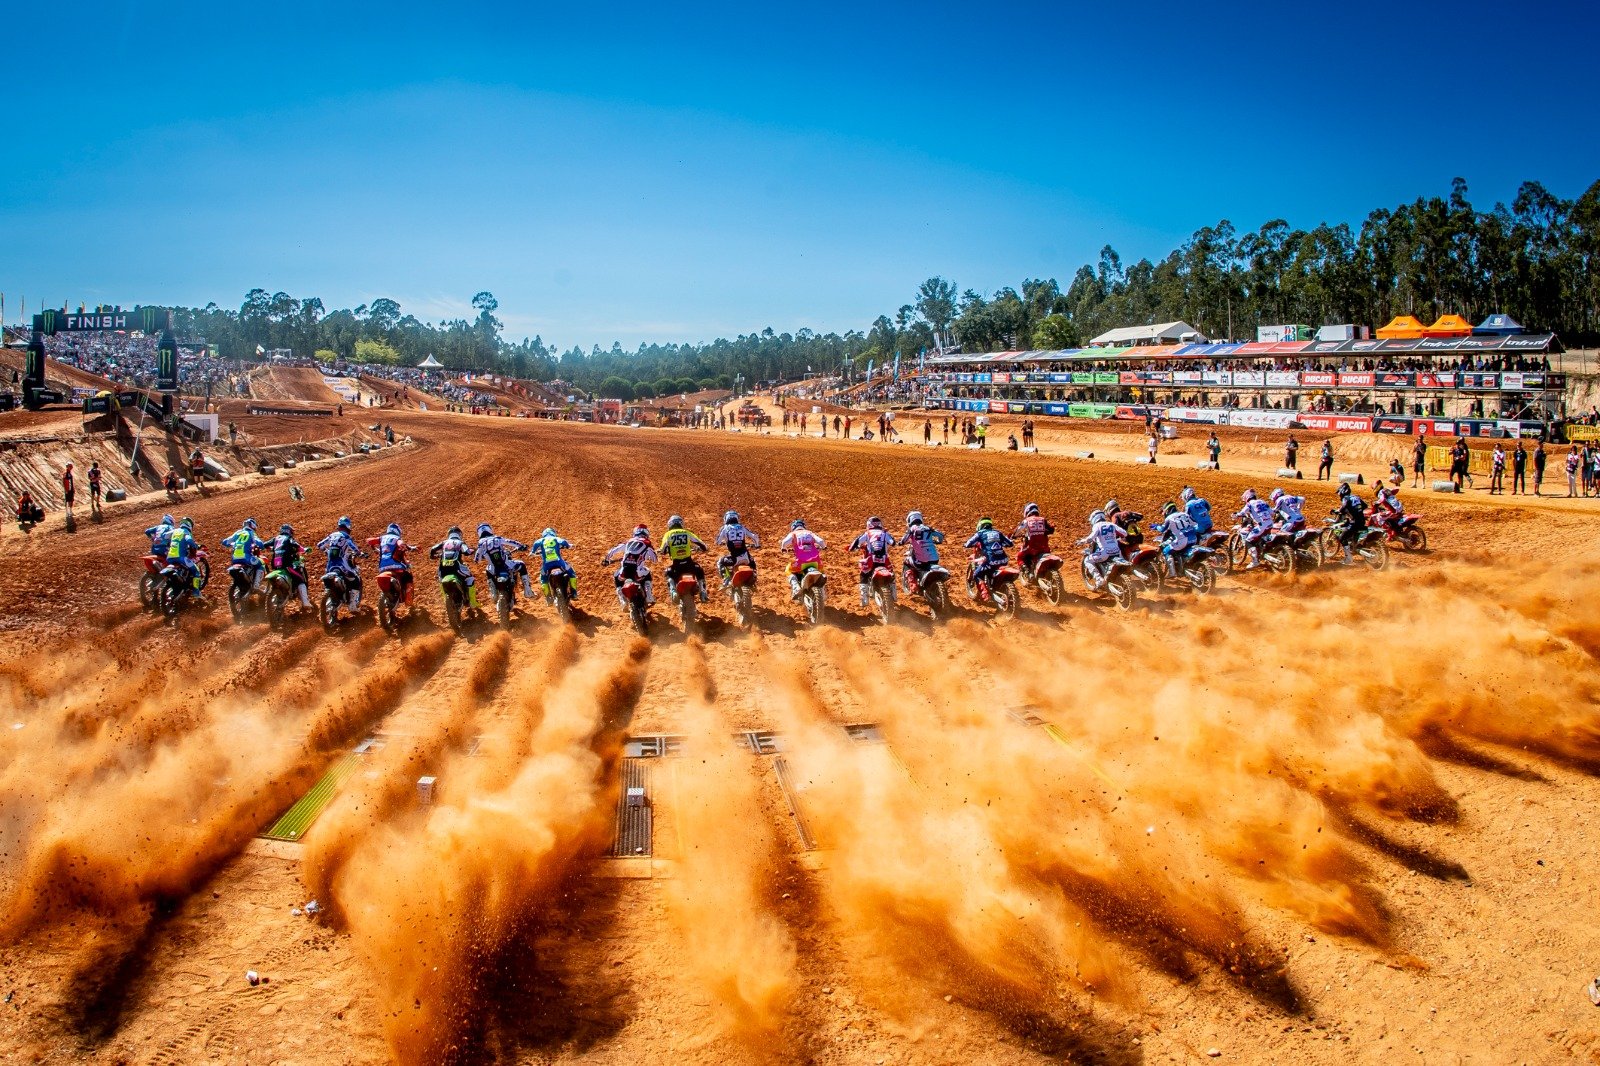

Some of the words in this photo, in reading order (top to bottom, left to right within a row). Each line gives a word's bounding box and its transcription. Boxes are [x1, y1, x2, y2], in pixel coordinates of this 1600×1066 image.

[67, 315, 126, 329] FINISH
[1304, 375, 1333, 383] DUCATI
[1341, 375, 1371, 384] DUCATI
[1336, 420, 1368, 430] DUCATI
[1101, 524, 1115, 536] 64
[671, 534, 688, 547] 253
